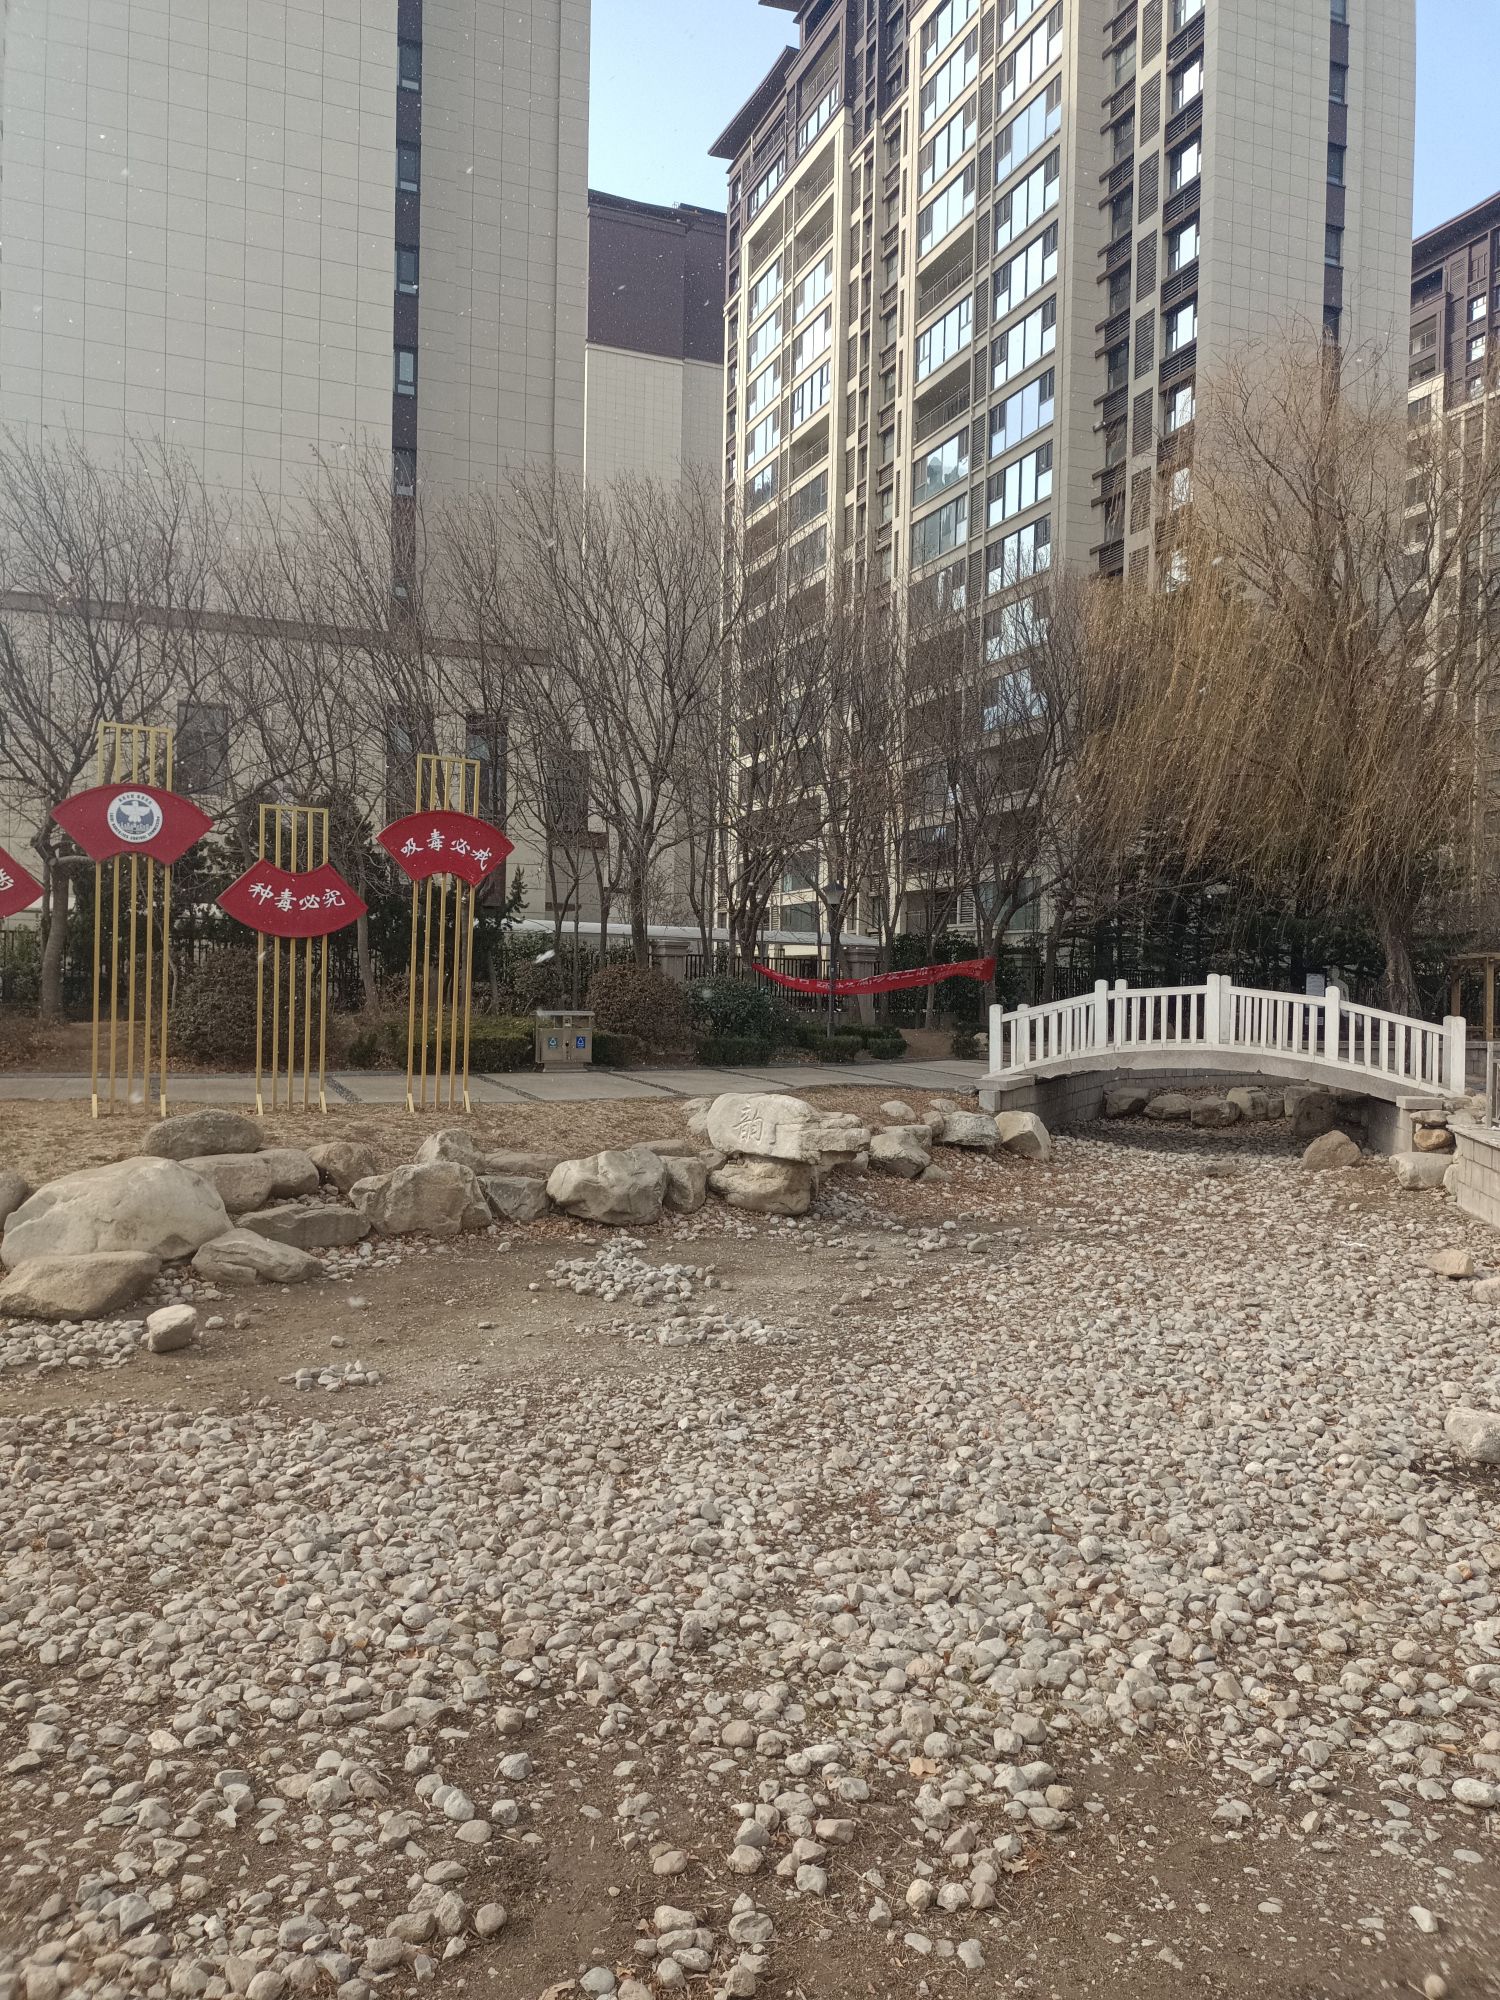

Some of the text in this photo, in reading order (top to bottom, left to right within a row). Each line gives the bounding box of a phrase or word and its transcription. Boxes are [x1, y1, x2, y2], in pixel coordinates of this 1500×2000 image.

[400, 828, 492, 871] 吸毒必戒
[248, 882, 346, 912] 种毒必究
